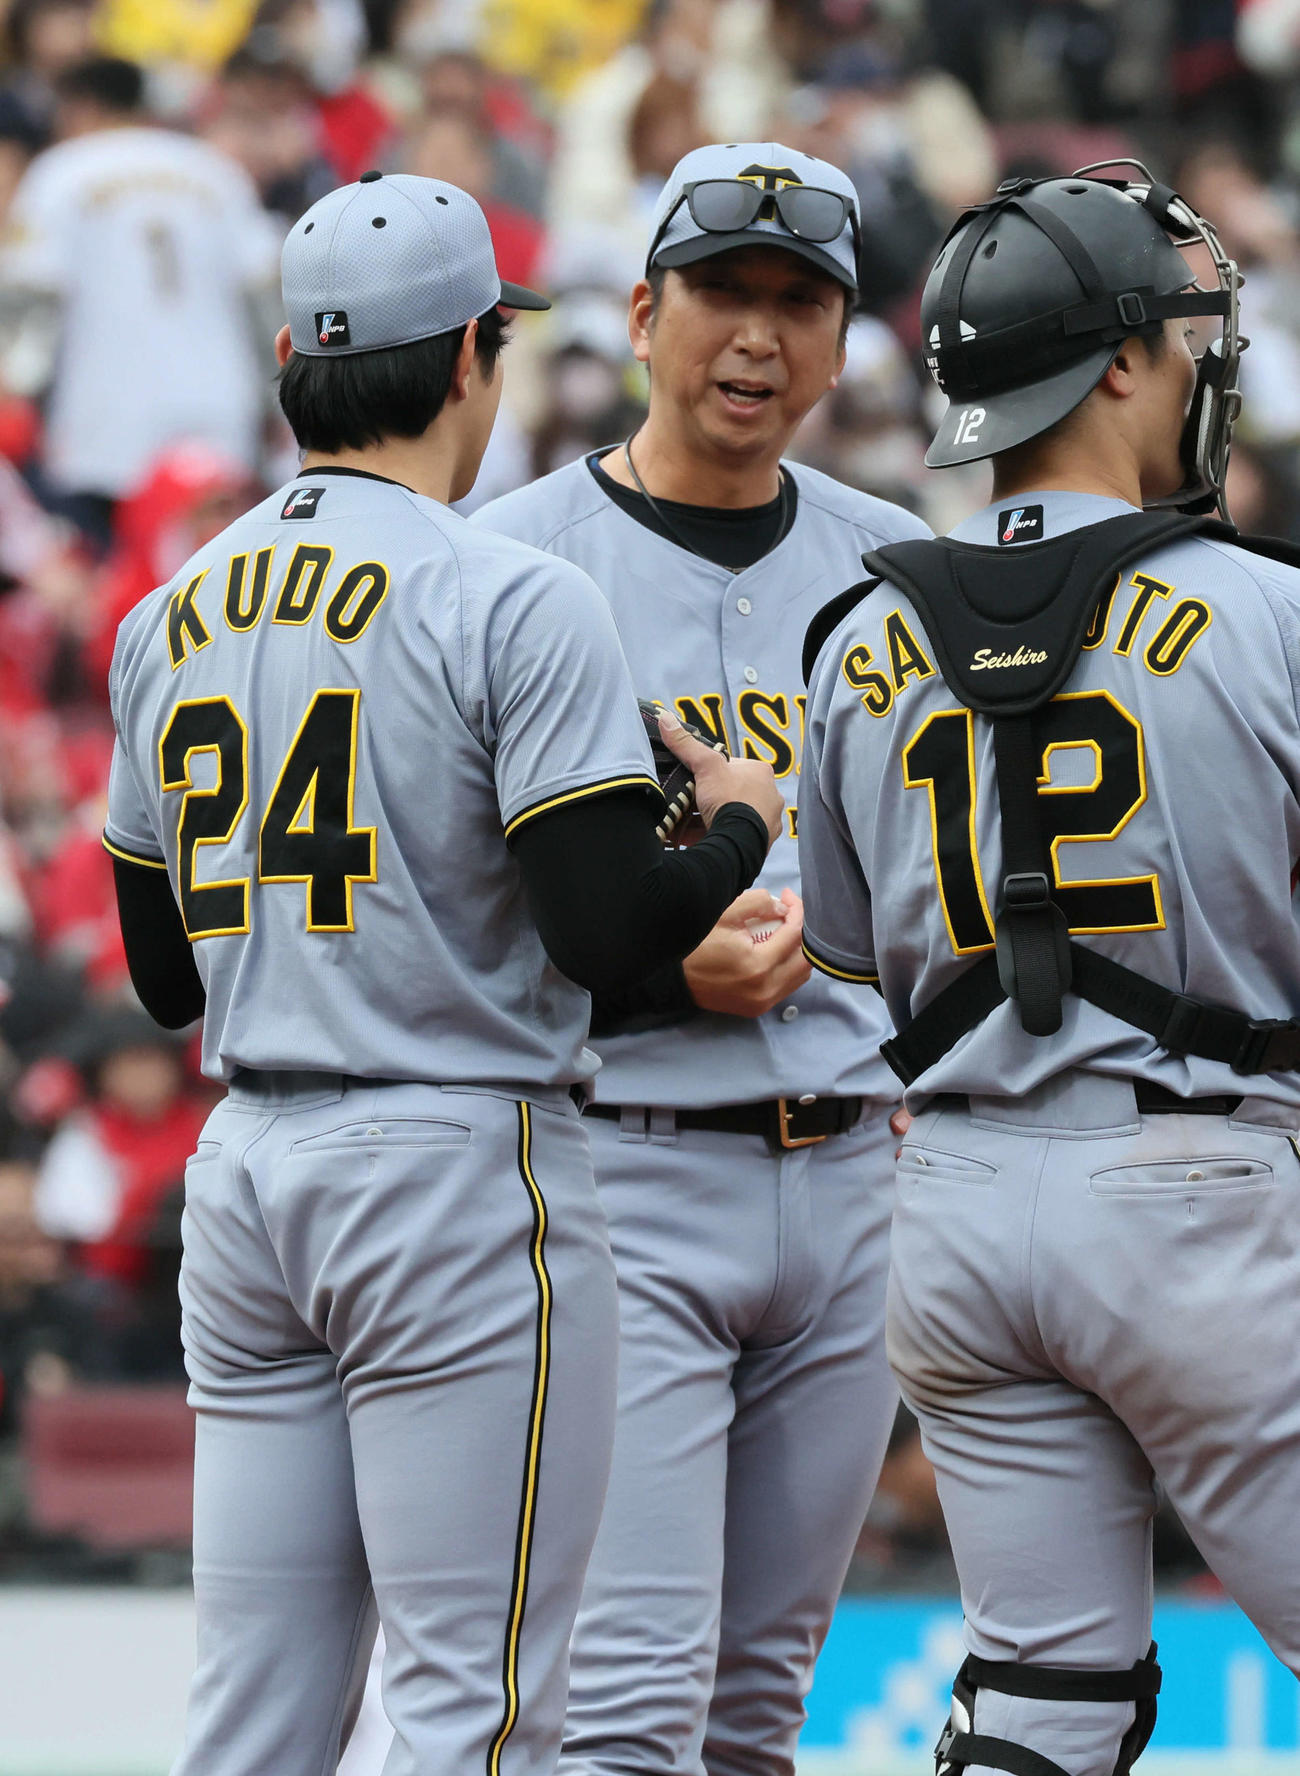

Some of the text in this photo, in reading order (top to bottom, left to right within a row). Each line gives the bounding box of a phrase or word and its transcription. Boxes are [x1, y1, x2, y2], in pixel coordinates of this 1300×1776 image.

[328, 325, 346, 333] NPB
[953, 408, 987, 445] 12
[1015, 519, 1038, 529] NPB
[166, 541, 391, 672] KUDO
[969, 645, 1049, 671] Seishiro
[158, 688, 378, 942] 24
[901, 689, 1167, 956] 12
